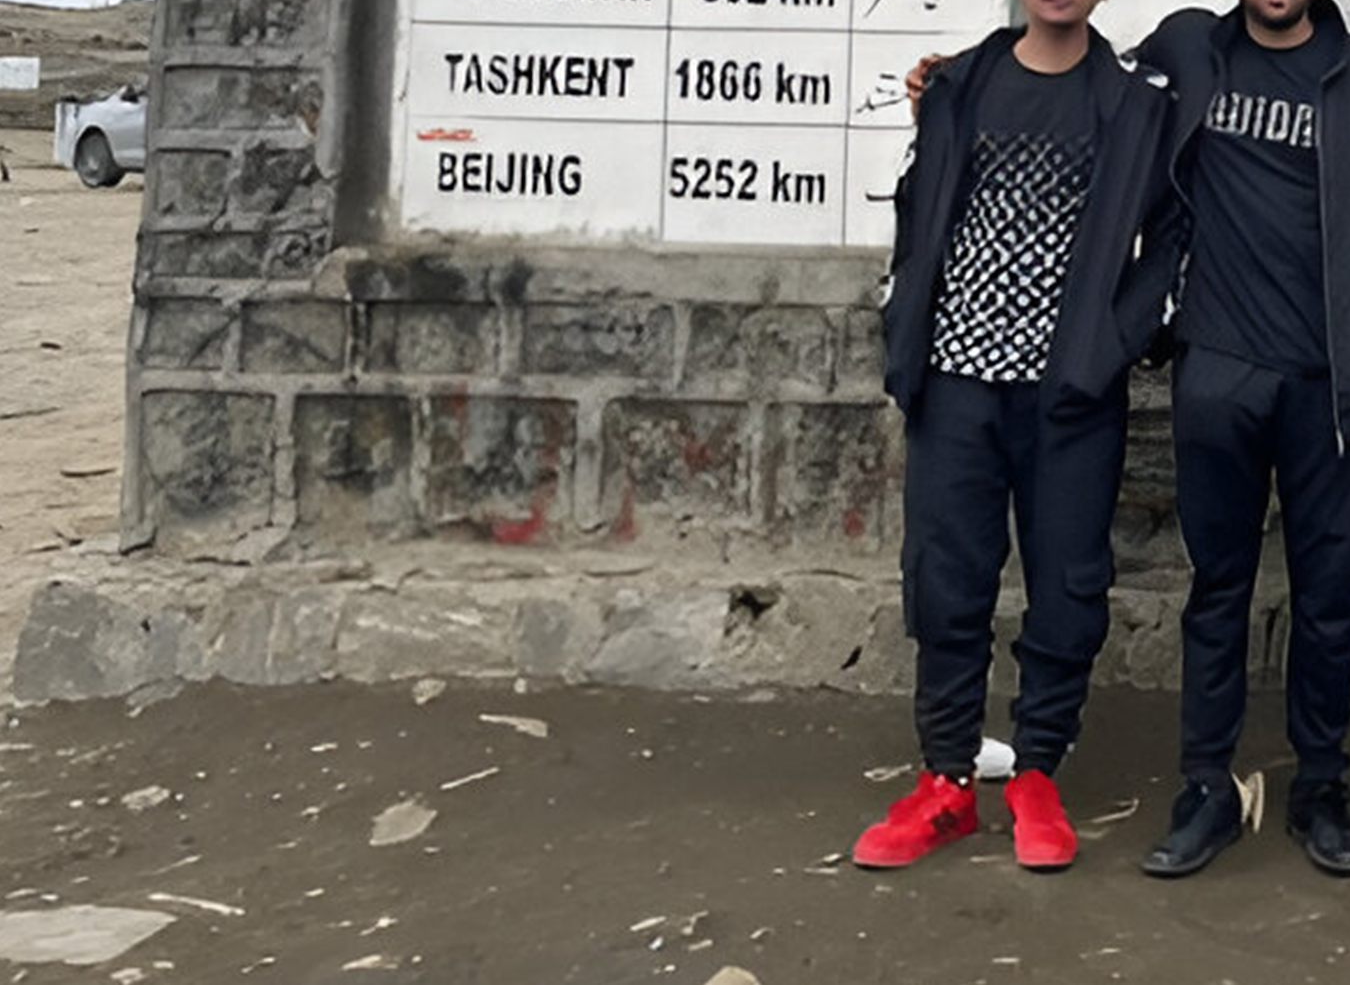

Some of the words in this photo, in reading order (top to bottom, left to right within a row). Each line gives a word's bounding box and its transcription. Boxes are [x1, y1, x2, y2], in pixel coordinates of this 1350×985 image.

[443, 53, 635, 98] TASHKENT
[674, 58, 763, 103] 1866
[775, 60, 831, 105] km
[437, 152, 582, 197] BEIJING
[669, 157, 758, 202] 5252
[771, 159, 826, 205] km
